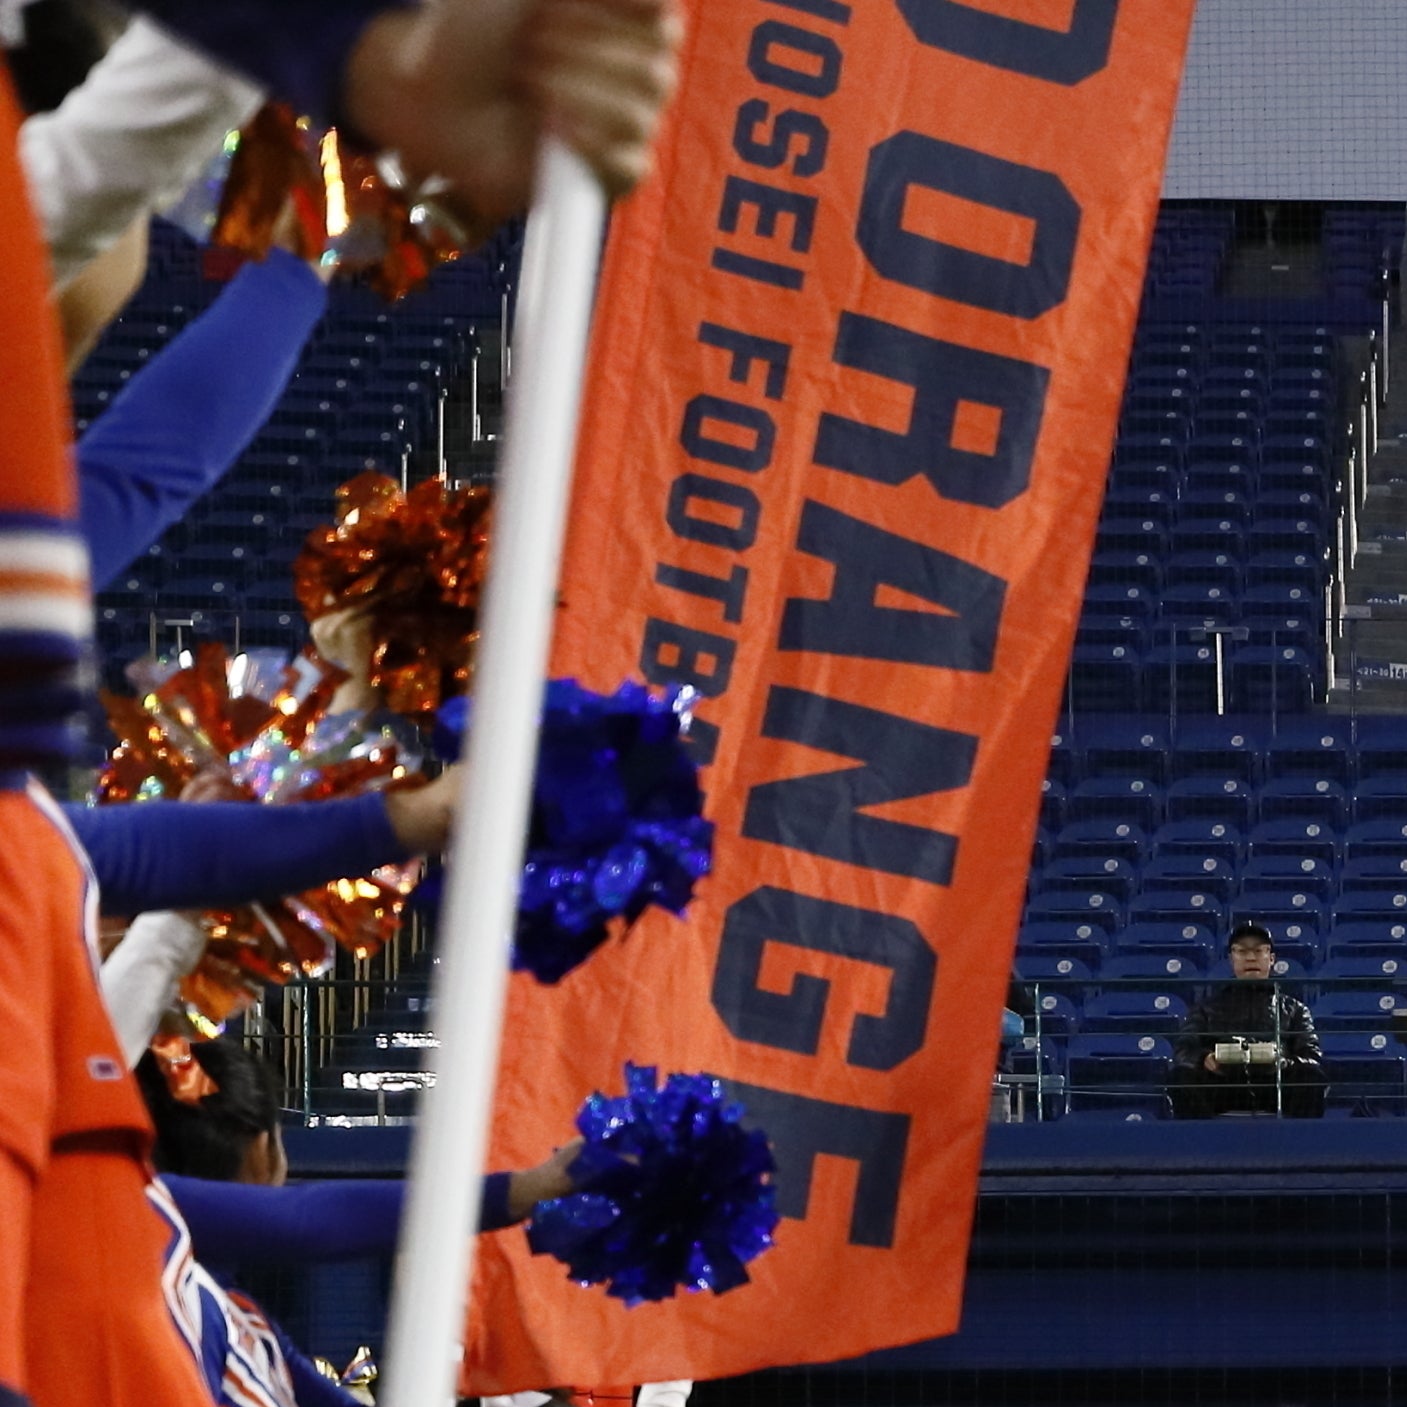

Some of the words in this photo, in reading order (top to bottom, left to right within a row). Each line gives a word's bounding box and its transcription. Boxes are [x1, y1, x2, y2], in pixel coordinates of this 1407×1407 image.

[711, 0, 854, 290] OSEI
[639, 322, 792, 766] FOOTB
[703, 130, 1083, 1250] ORANGE
